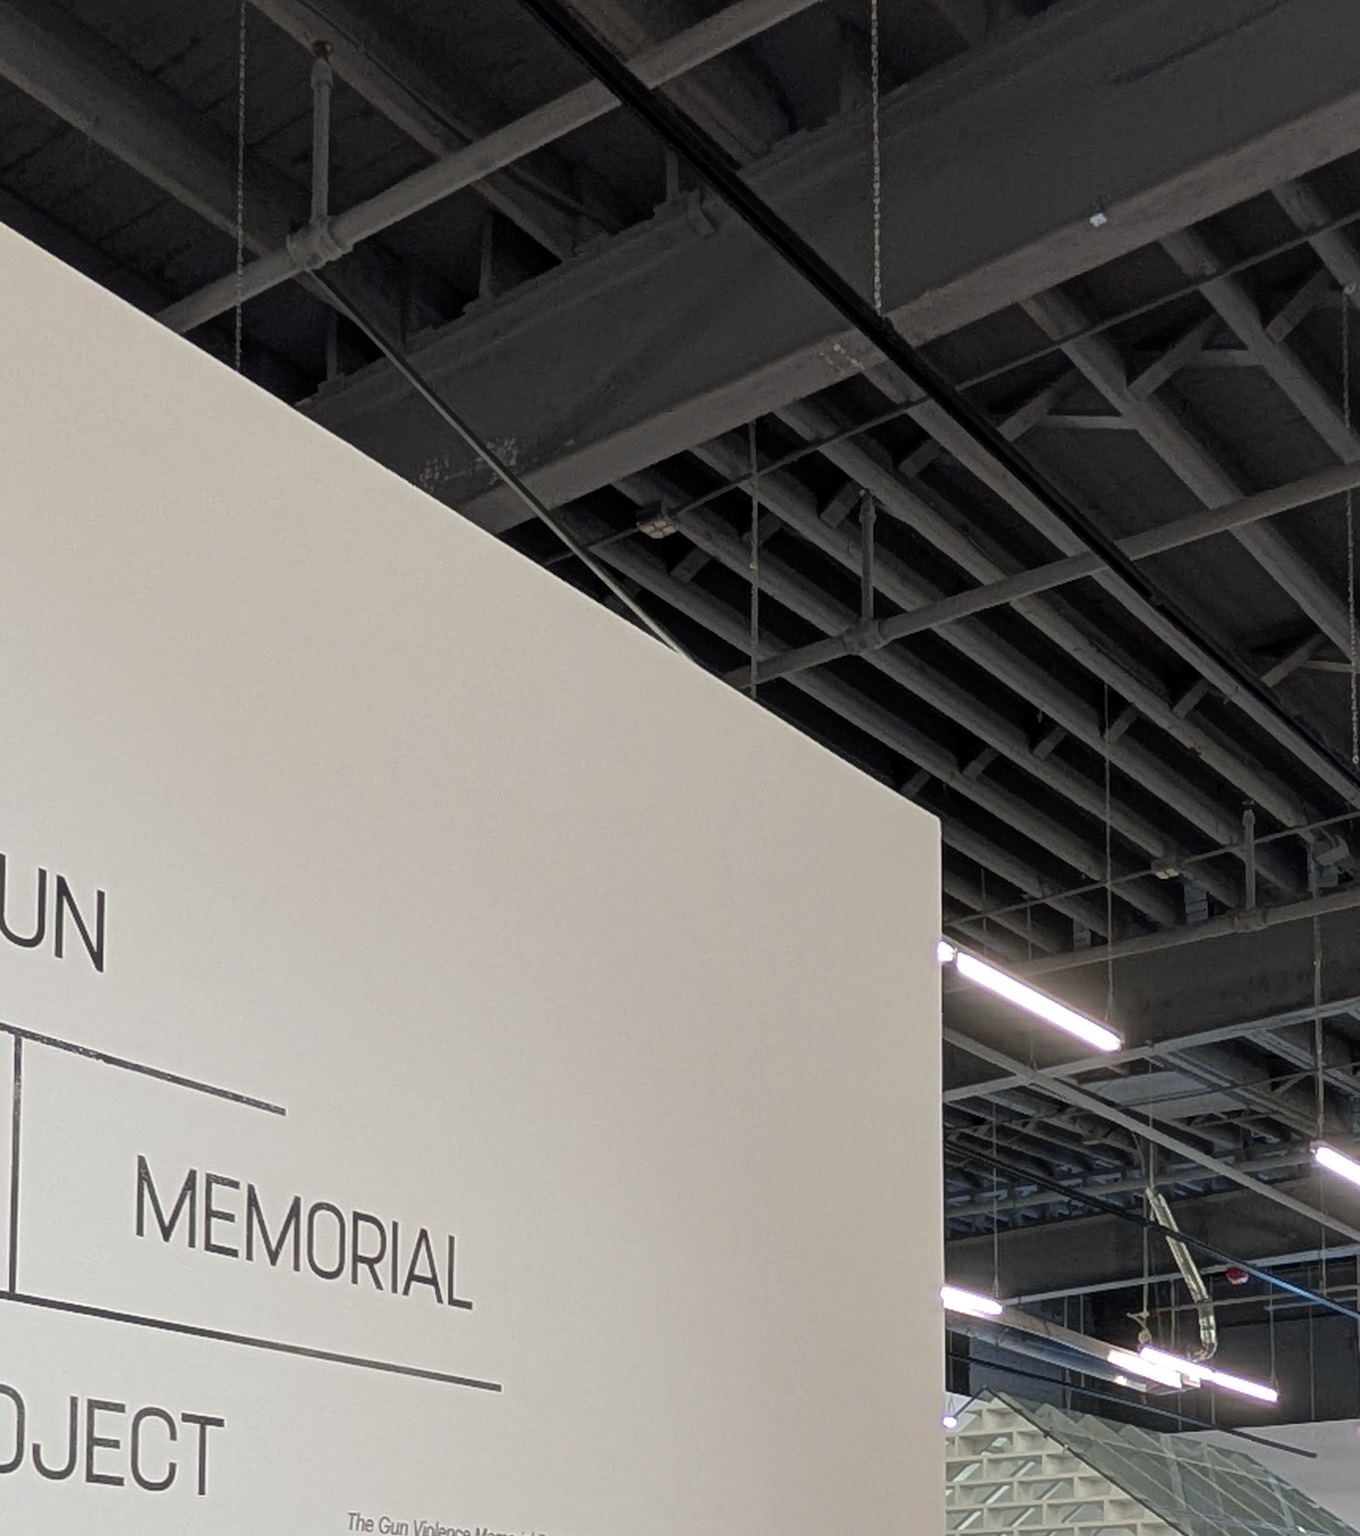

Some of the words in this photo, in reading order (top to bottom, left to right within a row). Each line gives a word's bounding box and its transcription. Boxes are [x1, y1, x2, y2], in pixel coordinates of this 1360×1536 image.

[136, 1155, 473, 1309] MEMORIAL
[348, 1511, 374, 1533] The
[378, 1515, 408, 1536] Gun
